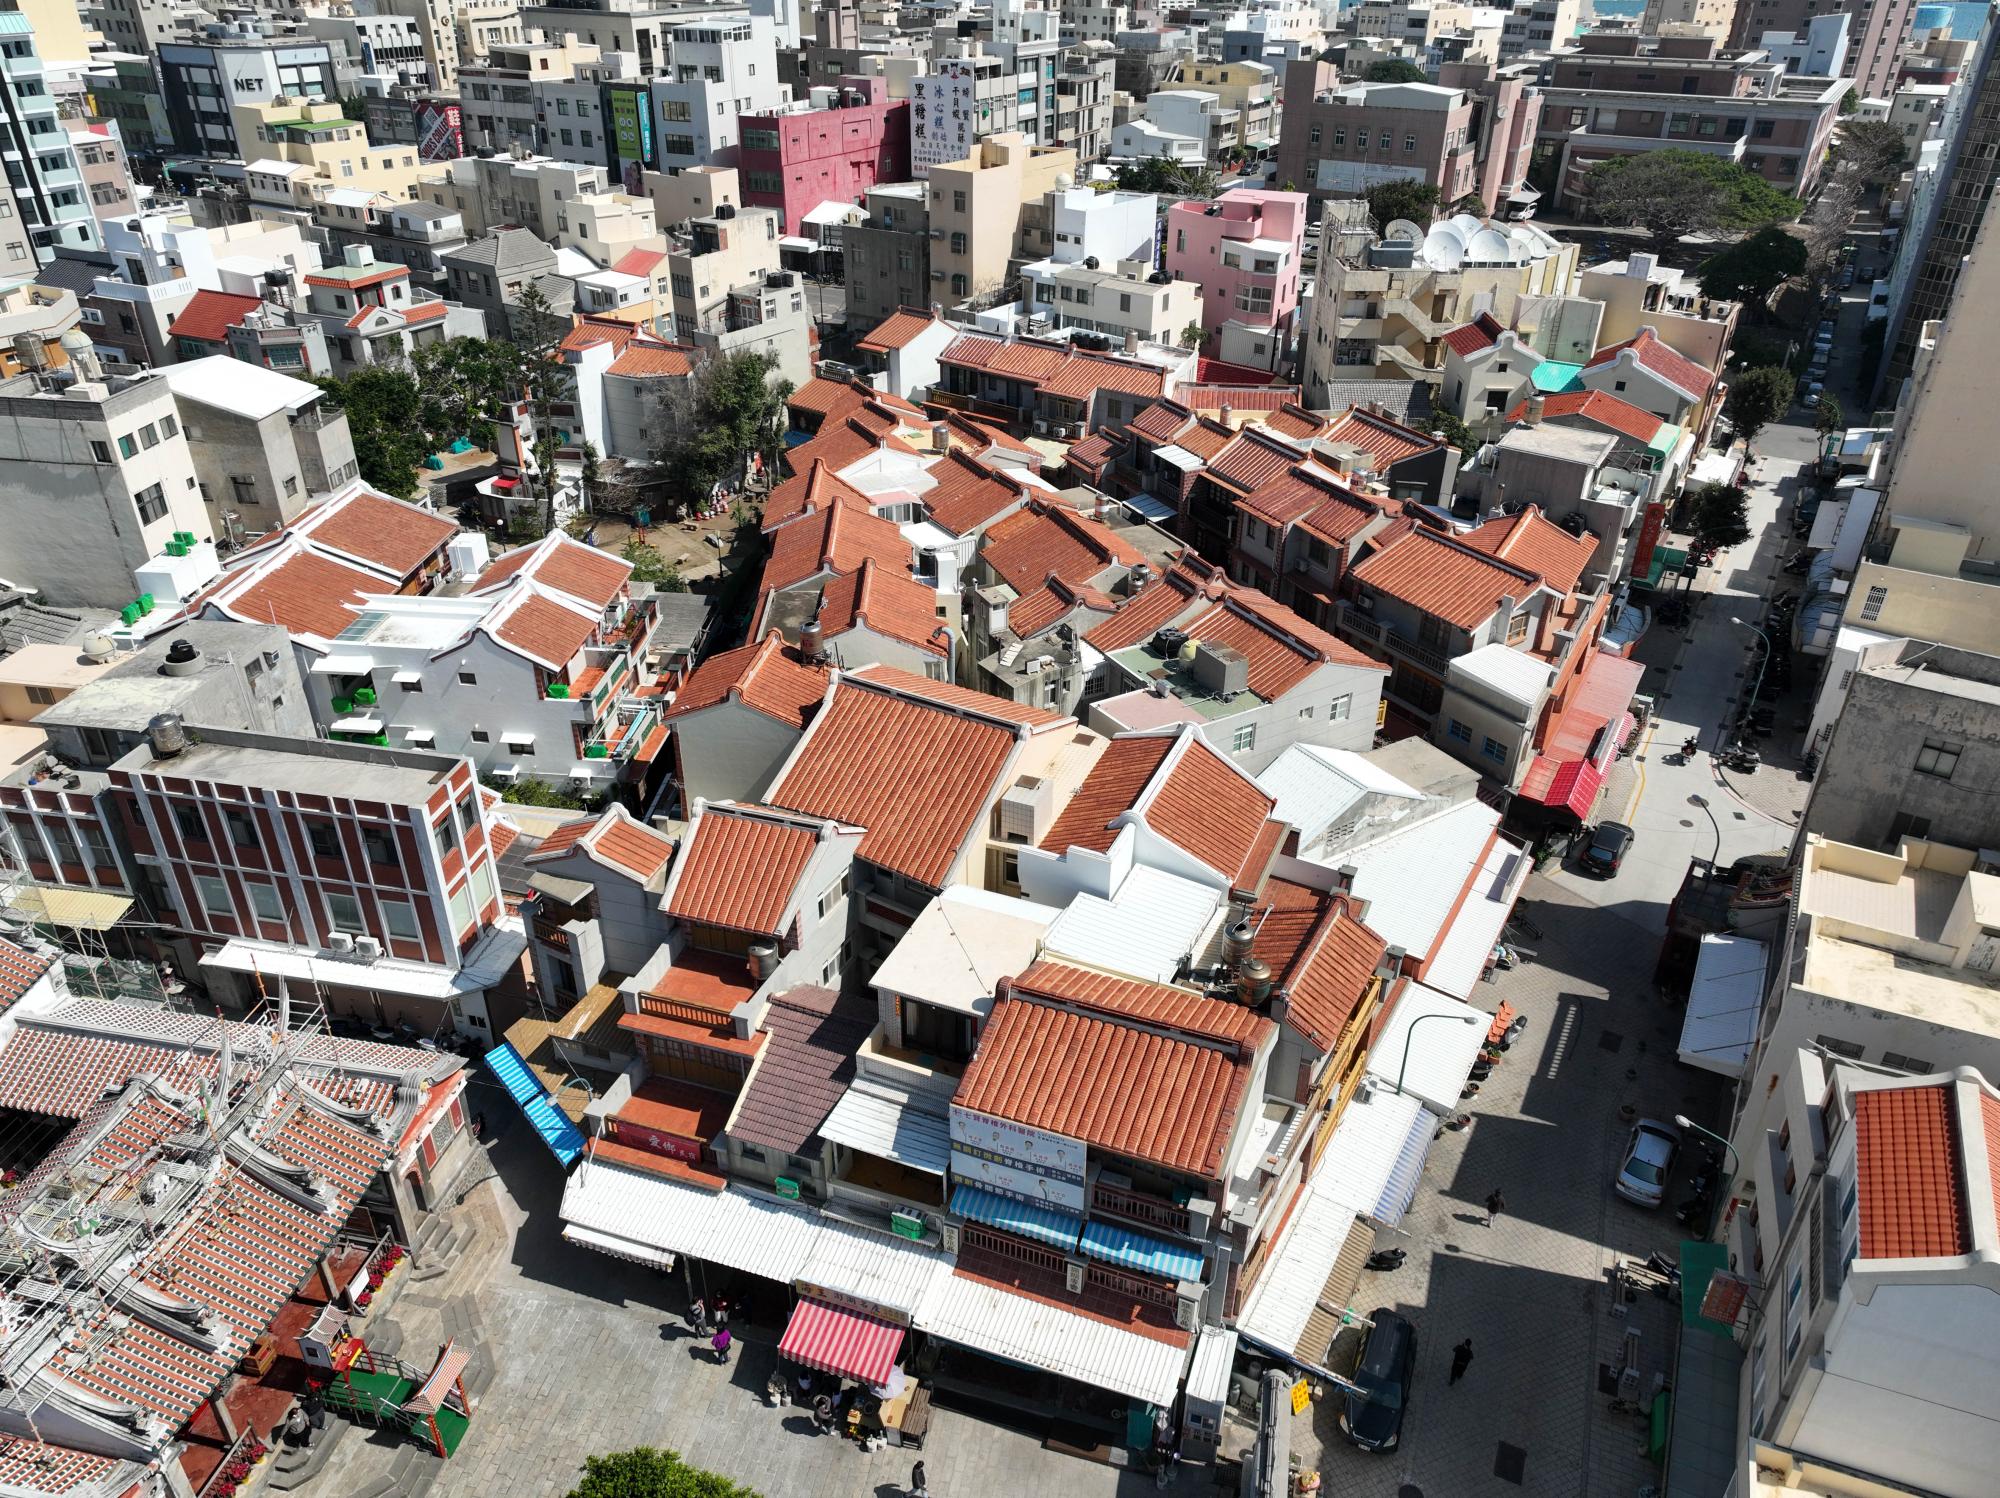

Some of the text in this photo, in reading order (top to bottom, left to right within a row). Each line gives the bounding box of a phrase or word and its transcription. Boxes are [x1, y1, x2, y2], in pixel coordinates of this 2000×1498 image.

[234, 78, 263, 91] NET
[935, 84, 944, 130] 冰心糕
[915, 83, 926, 139] 黑糖糕
